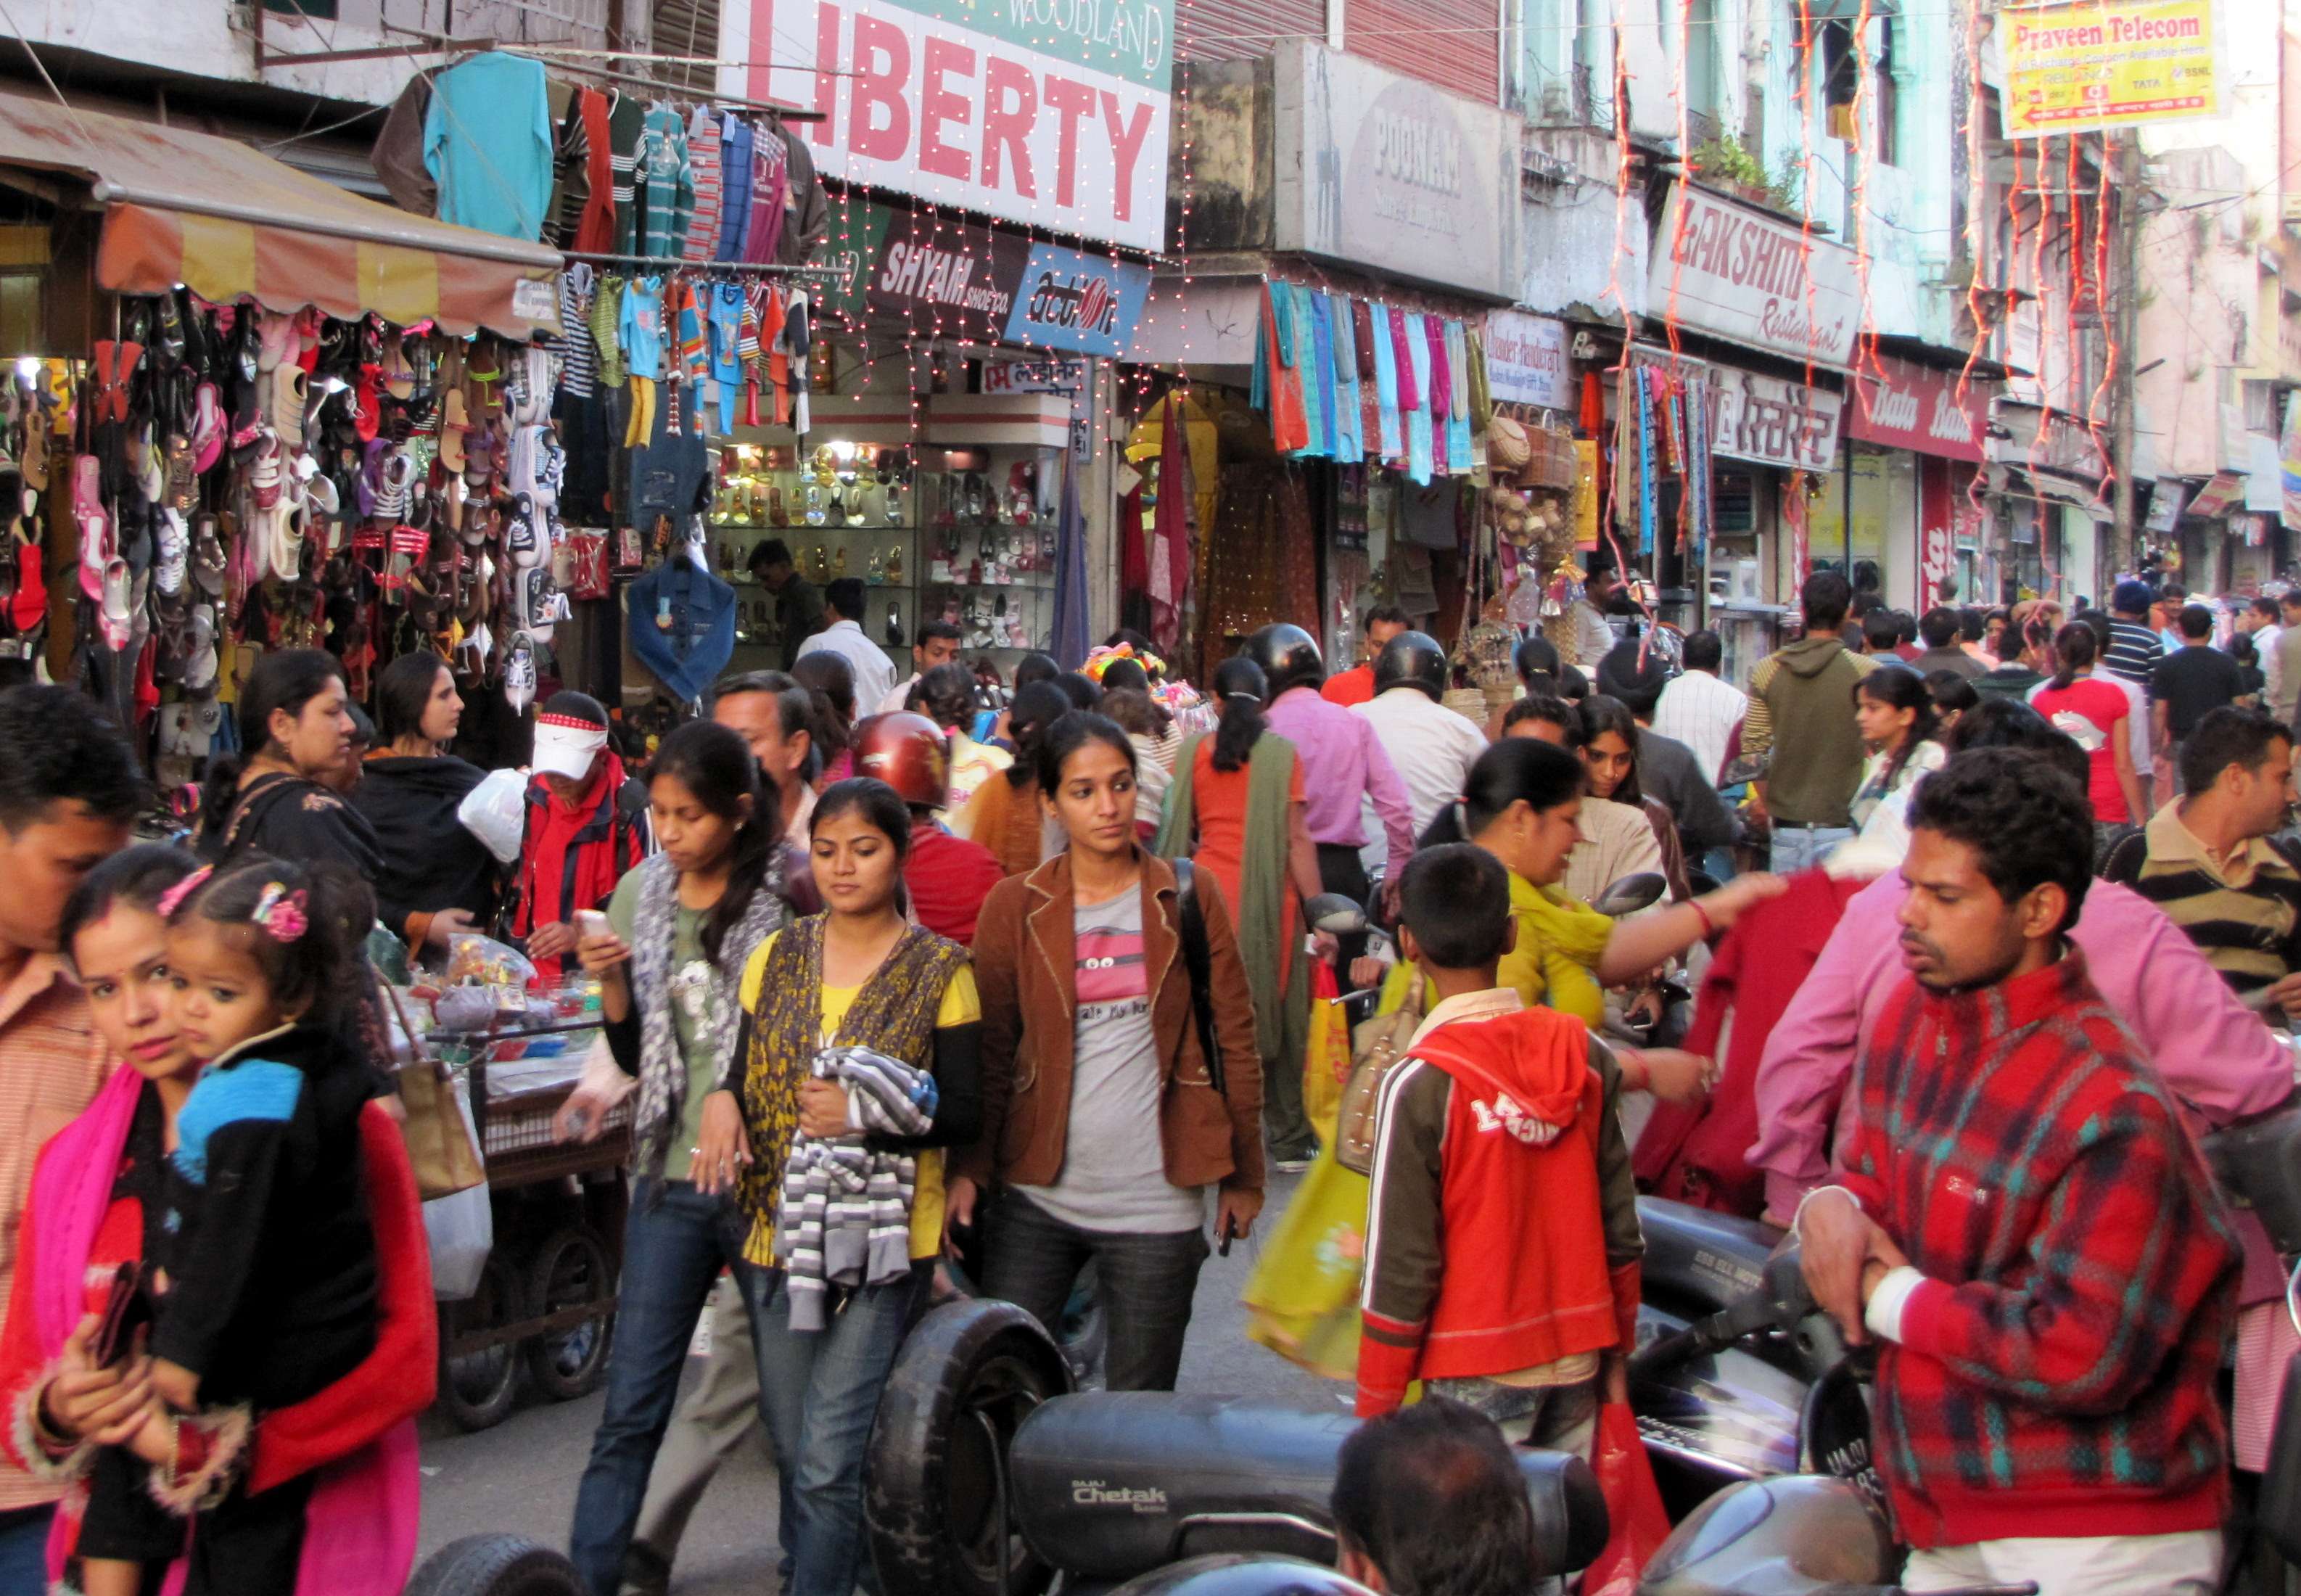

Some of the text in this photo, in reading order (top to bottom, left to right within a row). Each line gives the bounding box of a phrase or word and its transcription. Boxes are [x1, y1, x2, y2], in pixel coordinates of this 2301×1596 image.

[2016, 15, 2200, 52] Praveen Telecom
[2132, 79, 2161, 90] TATA
[746, 0, 1156, 223] LIBERTY
[881, 242, 975, 305] SHYAM
[967, 286, 994, 311] SHOE
[1870, 382, 1919, 432] Bata
[1073, 1487, 1167, 1504] Chetak
